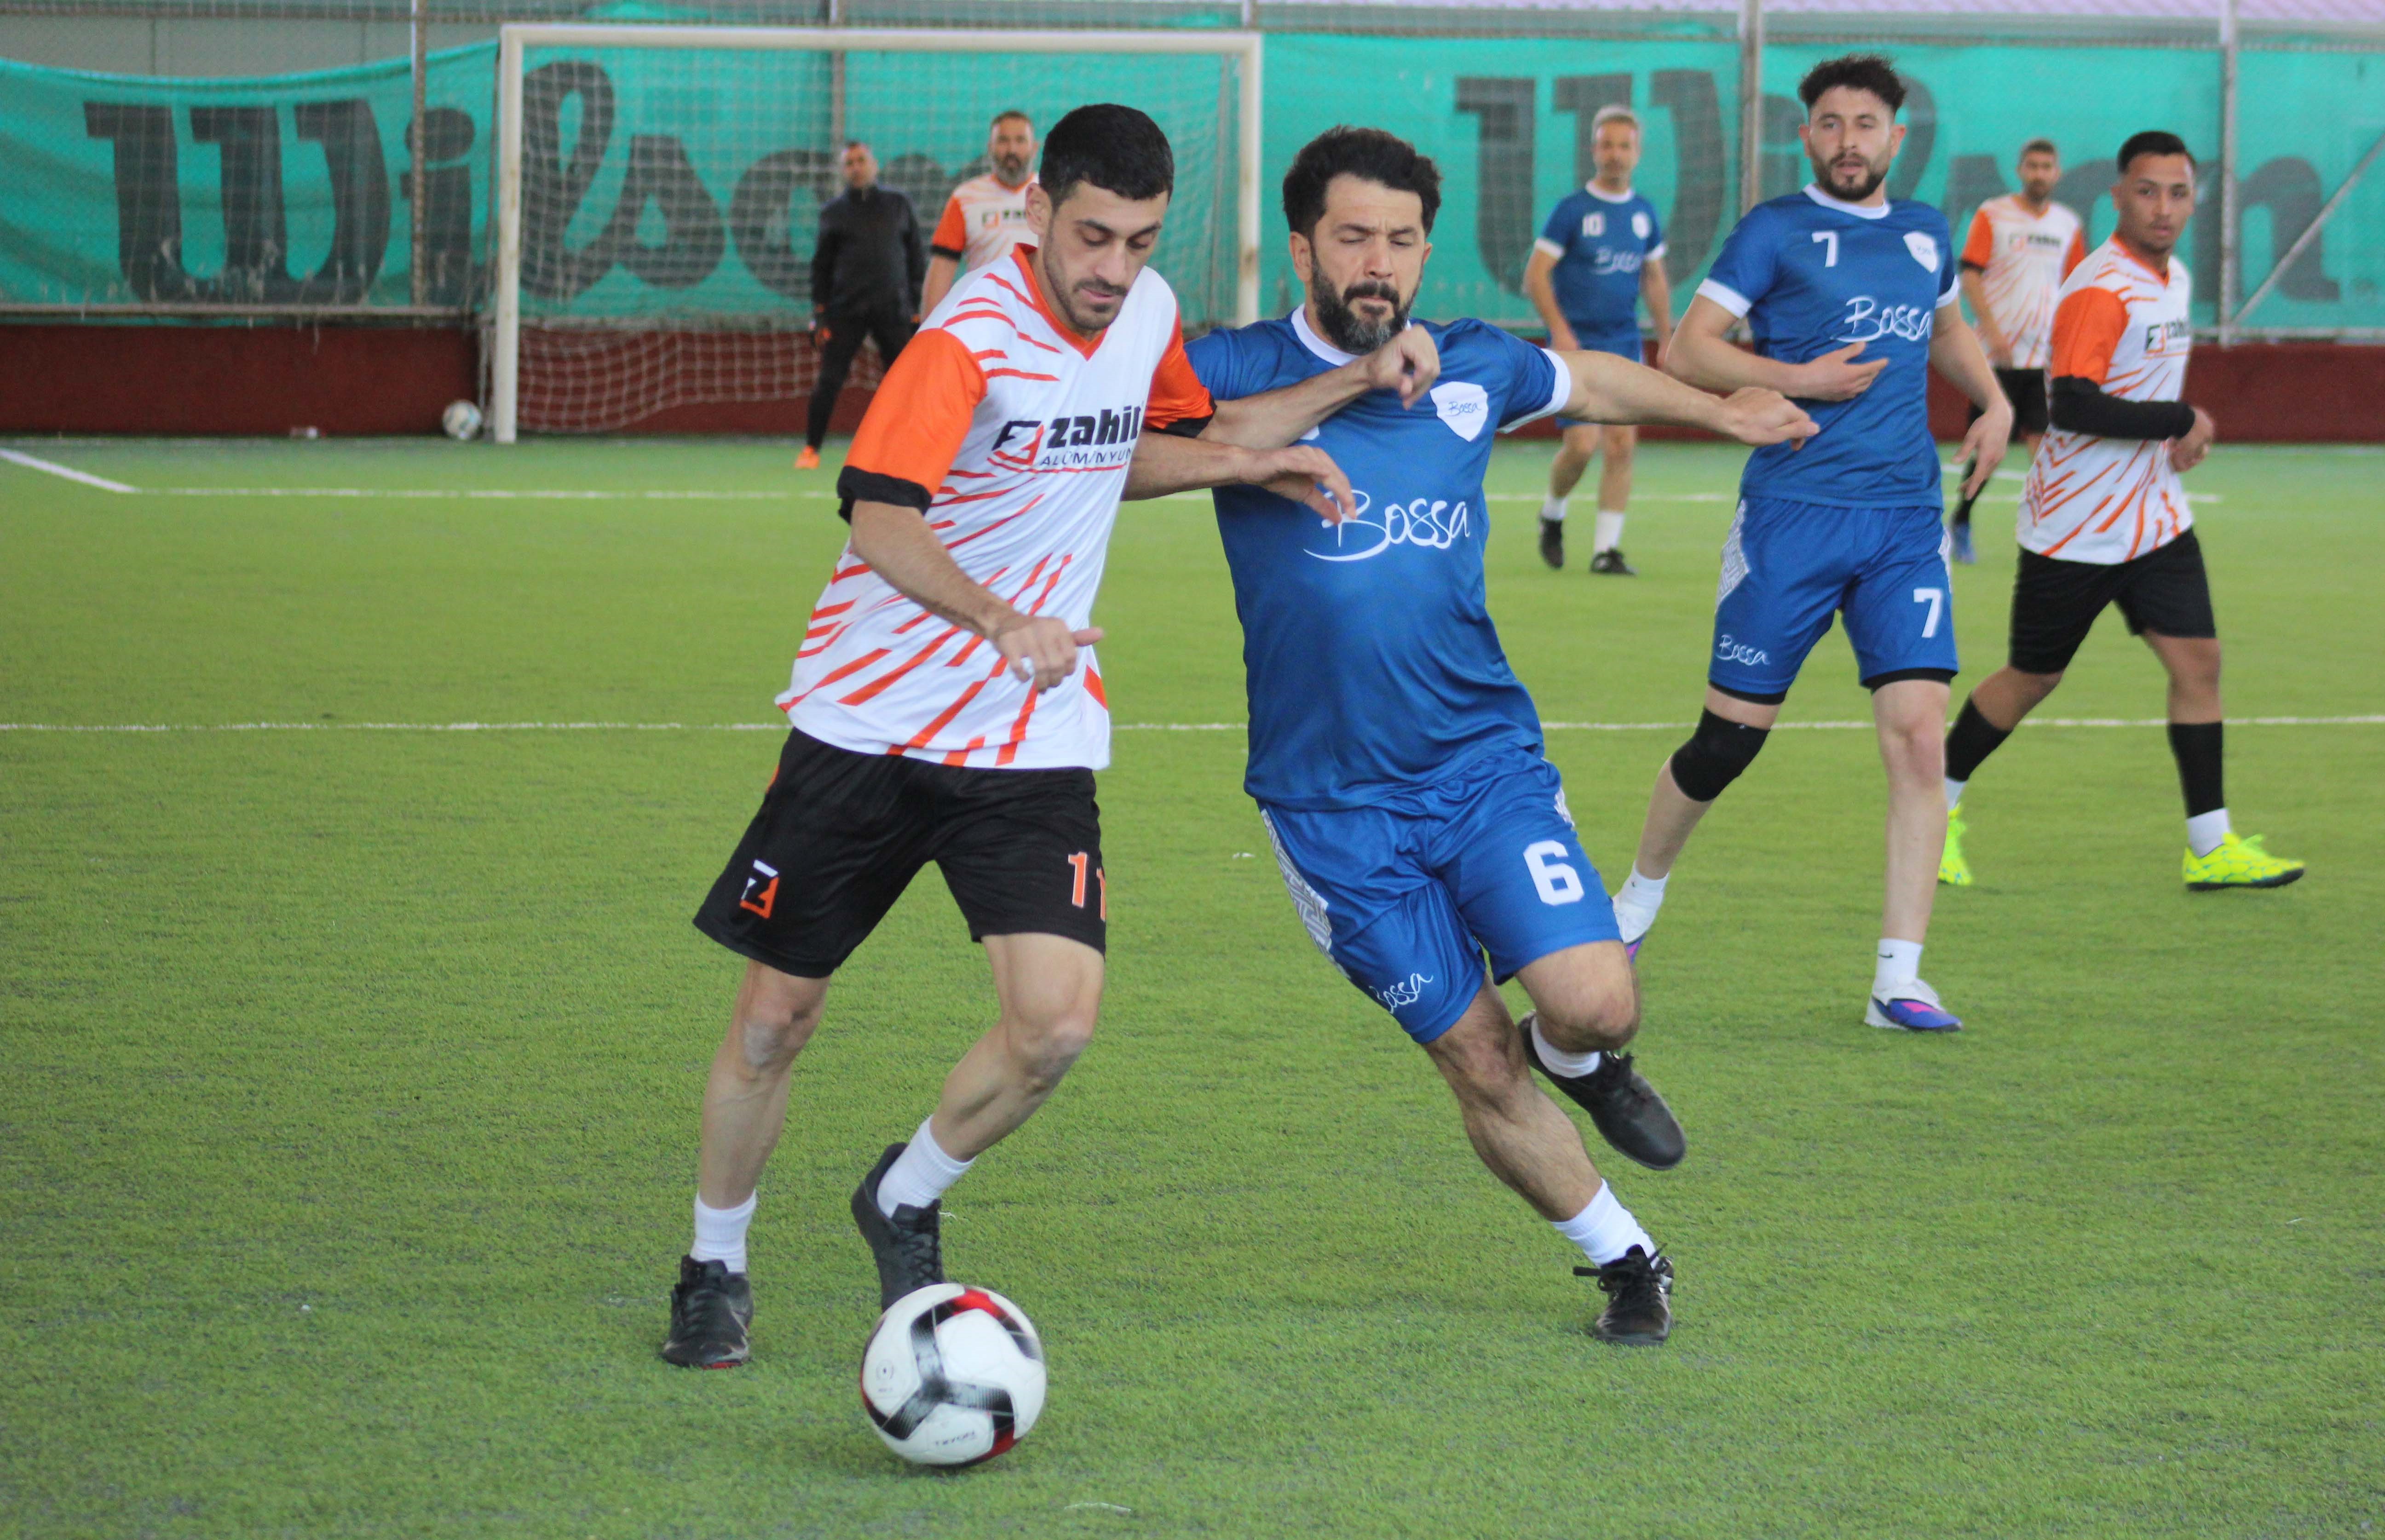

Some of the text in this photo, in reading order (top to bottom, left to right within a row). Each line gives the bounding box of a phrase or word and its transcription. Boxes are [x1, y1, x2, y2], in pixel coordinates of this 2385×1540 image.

[83, 61, 994, 309] Wilso
[1454, 68, 2341, 304] Win
[1582, 213, 1606, 237] 10
[1811, 231, 1838, 268] 7
[1830, 296, 1933, 342] Bossa
[1445, 401, 1481, 417] Bossa
[1303, 489, 1470, 562] Bossa
[1913, 587, 1943, 638] 7
[1715, 634, 1771, 666] Bossa
[1523, 839, 1584, 906] 6
